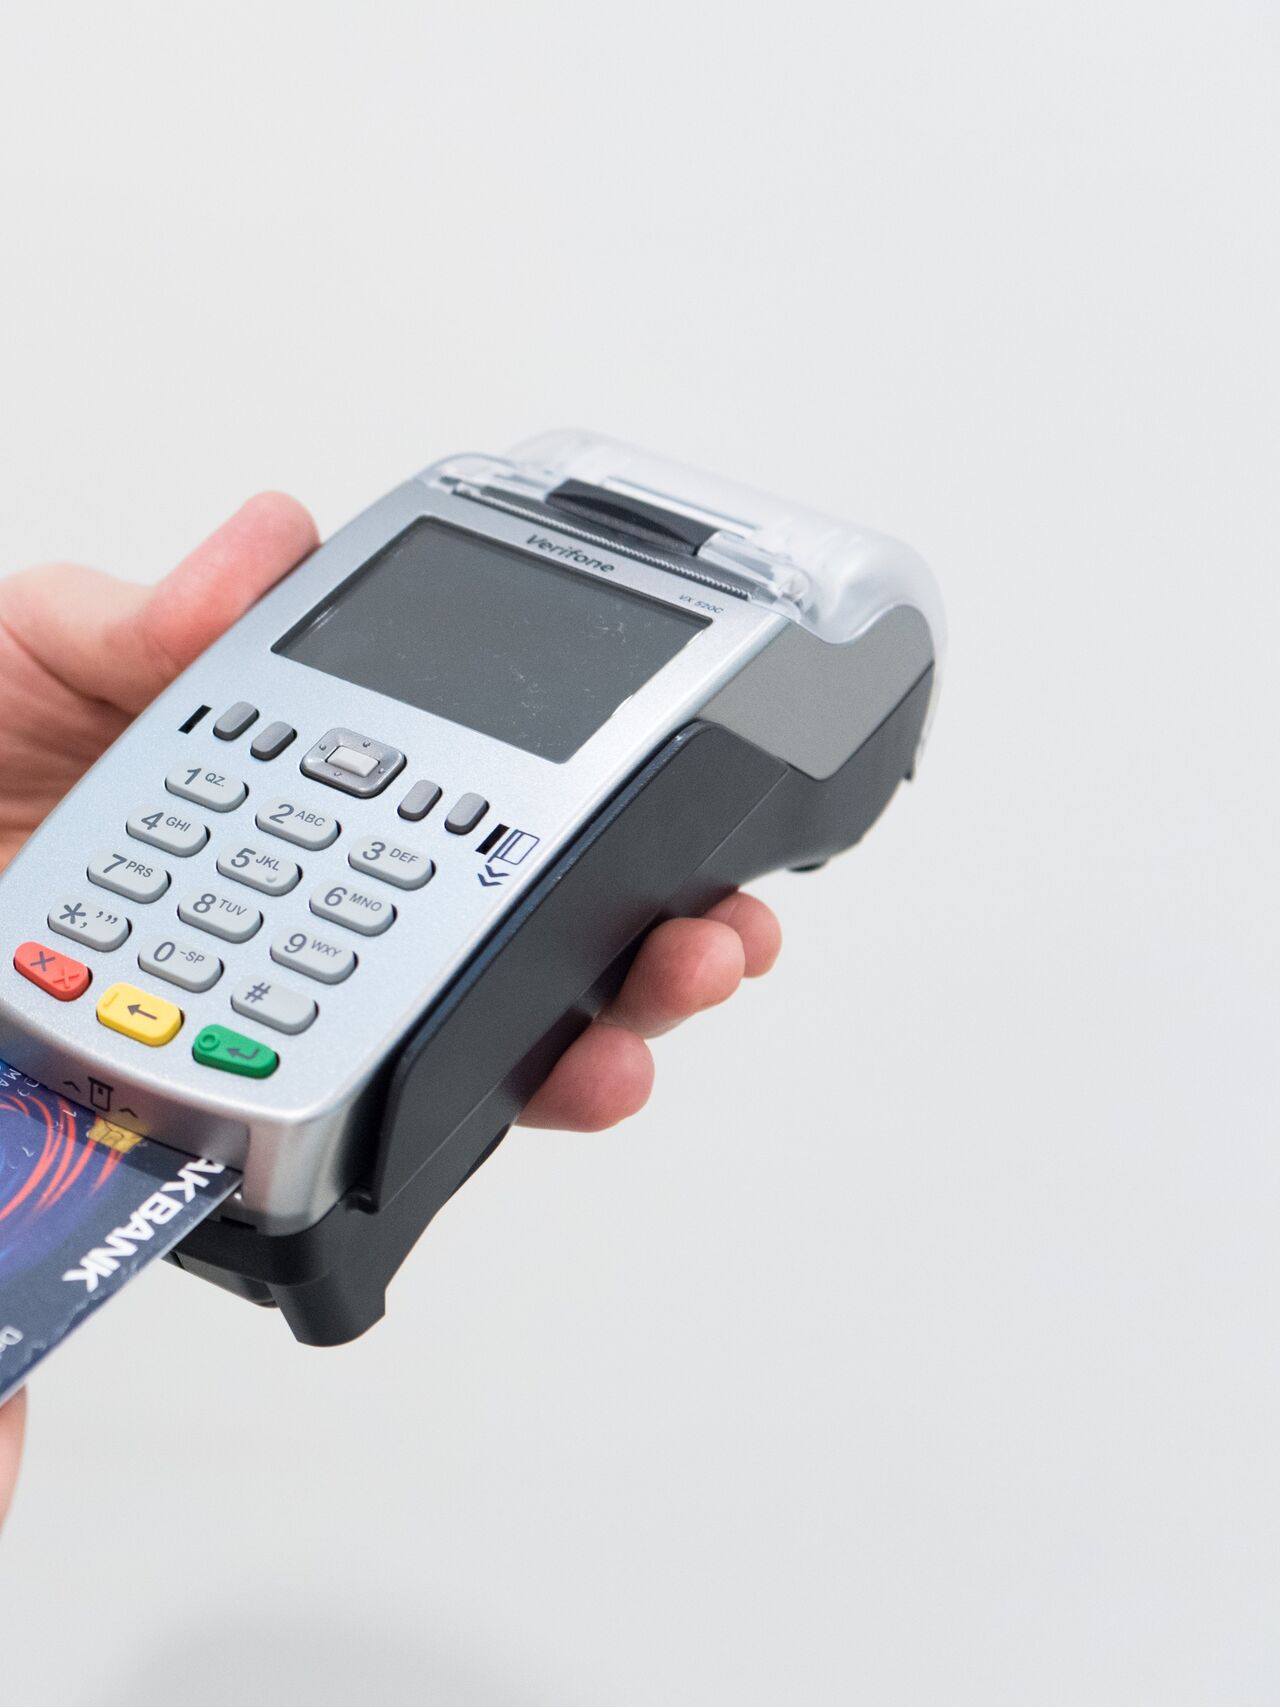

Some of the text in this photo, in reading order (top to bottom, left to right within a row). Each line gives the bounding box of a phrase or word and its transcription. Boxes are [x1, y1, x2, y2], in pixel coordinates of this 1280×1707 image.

[525, 534, 615, 573] Verifone
[184, 768, 202, 785] 1
[141, 811, 192, 832] 4 GHI
[269, 803, 326, 827] 2 ABC
[230, 847, 280, 871] 5 JKL
[362, 841, 419, 865] 3 DEF
[103, 853, 154, 878] 7 PRS
[192, 893, 247, 917] 8 TUV
[324, 886, 383, 912] 6 MNO
[153, 941, 176, 963] 0
[284, 933, 342, 959] 9 WXY
[244, 982, 272, 1004] #
[62, 1158, 226, 1293] AKBANK
